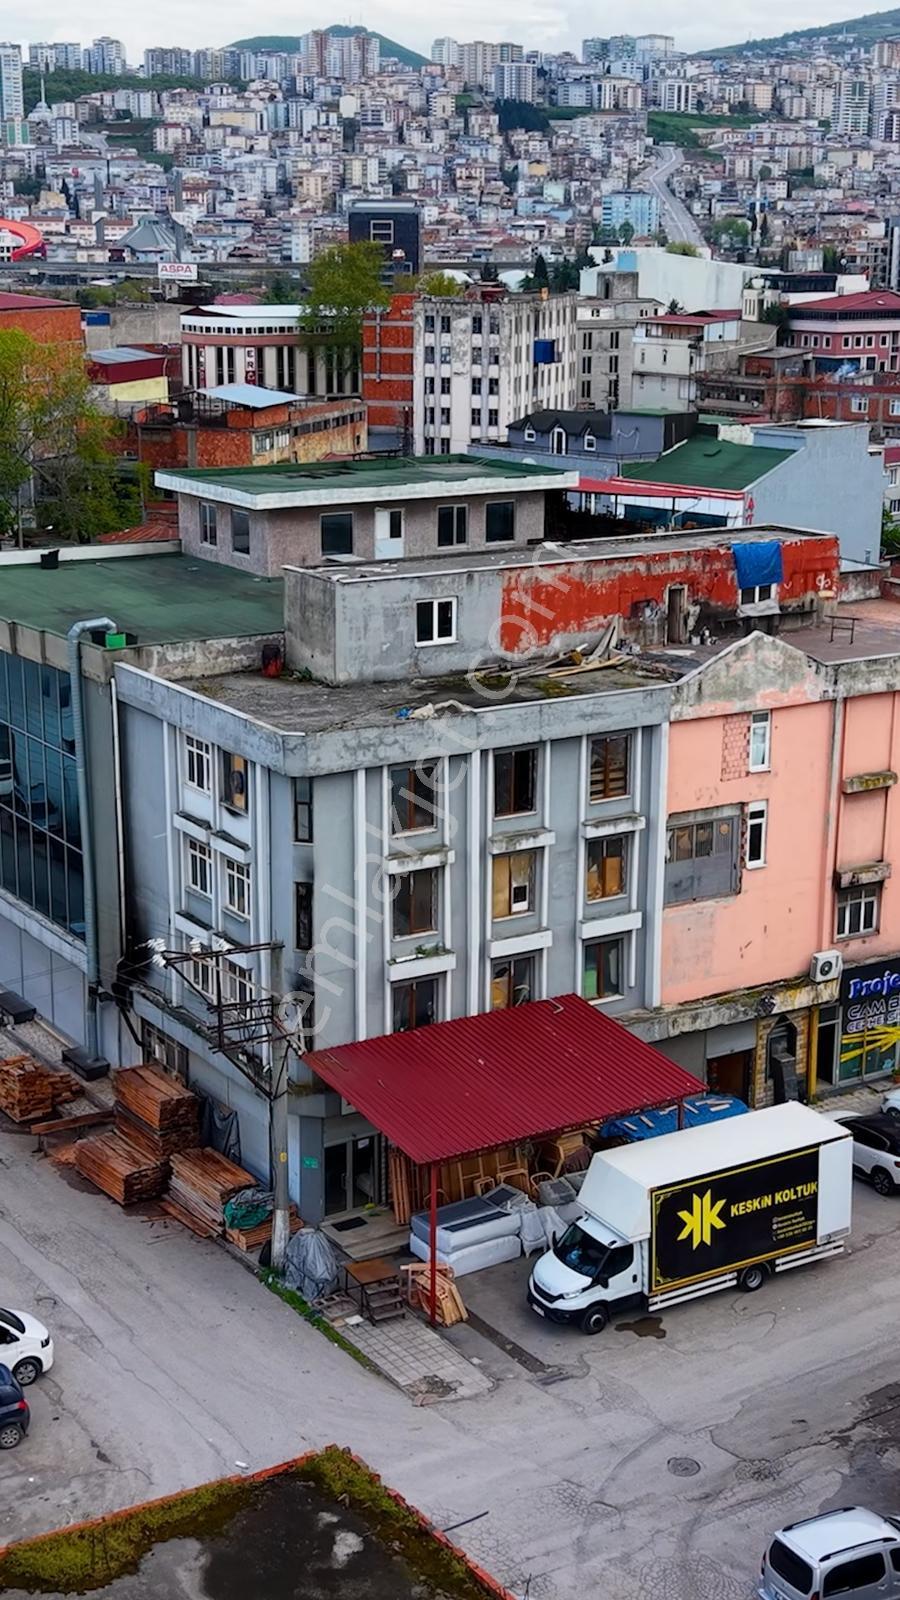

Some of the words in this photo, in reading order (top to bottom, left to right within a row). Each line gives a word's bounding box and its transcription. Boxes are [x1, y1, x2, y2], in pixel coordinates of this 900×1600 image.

[160, 264, 192, 274] ASPA
[847, 999, 886, 1021] CAM
[774, 1181, 818, 1205] KOLTUK
